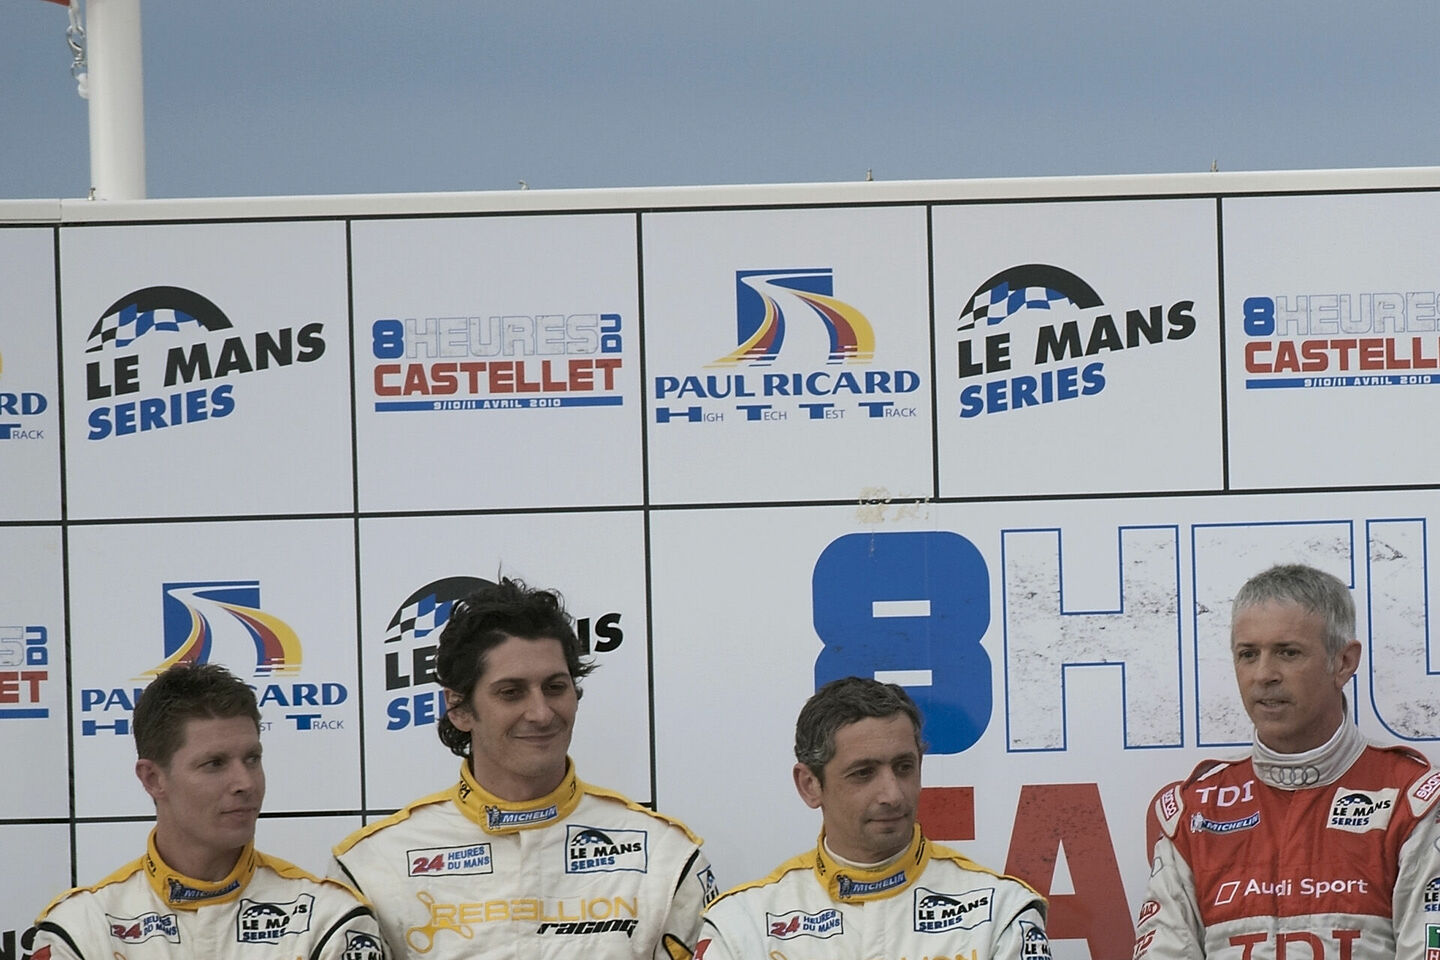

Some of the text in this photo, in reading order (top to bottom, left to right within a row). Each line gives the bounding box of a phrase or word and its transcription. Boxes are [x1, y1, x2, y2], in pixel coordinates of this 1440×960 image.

[1243, 296, 1275, 337] 8
[372, 313, 622, 360] 8 HEURES DU
[958, 299, 1197, 379] LE MANS
[86, 322, 326, 401] LE MANS
[373, 358, 623, 397] CASTELLET
[655, 369, 920, 400] PAUL RICARD
[1353, 376, 1393, 386] AVRIL
[958, 361, 1107, 419] SERIES
[87, 384, 236, 441] SERIES
[483, 399, 523, 410] AVRIL
[655, 401, 917, 424] HIGH TECH TEST TRACK
[812, 531, 993, 754] 8
[285, 714, 344, 730] TRACK
[1196, 781, 1254, 808] TDI
[502, 807, 556, 823] MICHELIN
[1333, 799, 1391, 817] LE MANS
[1206, 813, 1259, 832] MICHELIN
[1331, 816, 1369, 827] SERIES
[412, 846, 485, 875] 24 HEURES
[570, 841, 642, 859] LE MANS
[464, 856, 490, 869] MANS
[570, 857, 615, 871] SERIES
[852, 872, 905, 893] MICHELIN
[1244, 877, 1368, 898] Audi Sport
[918, 896, 989, 921] LE MANS
[536, 919, 638, 938] racing
[770, 917, 800, 936] 24
[919, 916, 963, 931] SERIES
